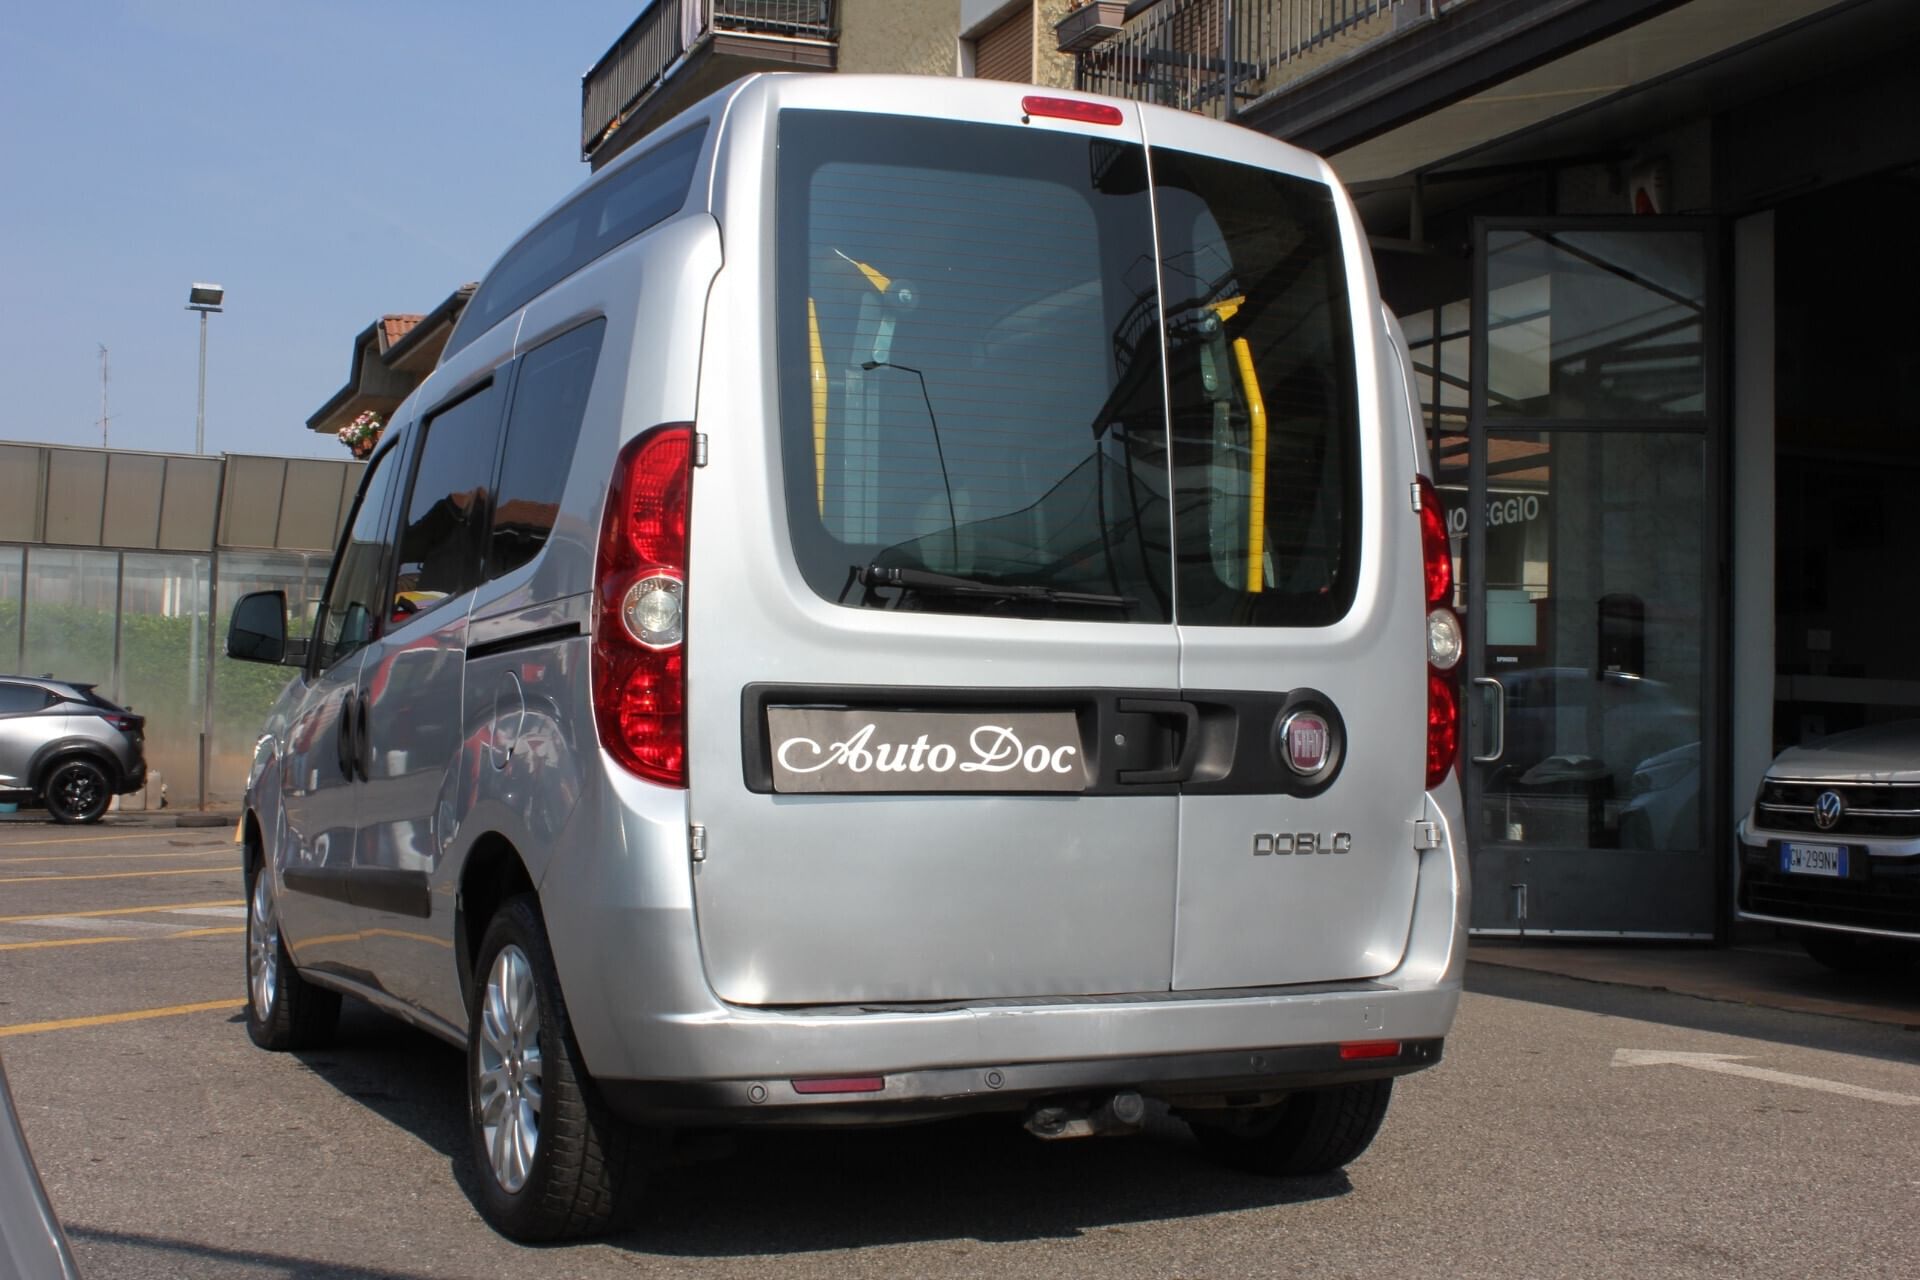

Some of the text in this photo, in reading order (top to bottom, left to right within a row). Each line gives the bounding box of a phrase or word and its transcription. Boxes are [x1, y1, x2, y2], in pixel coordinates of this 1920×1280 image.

[777, 723, 1077, 773] Auto Doc
[1294, 728, 1323, 758] FIAT
[1806, 850, 1838, 870] 299NW
